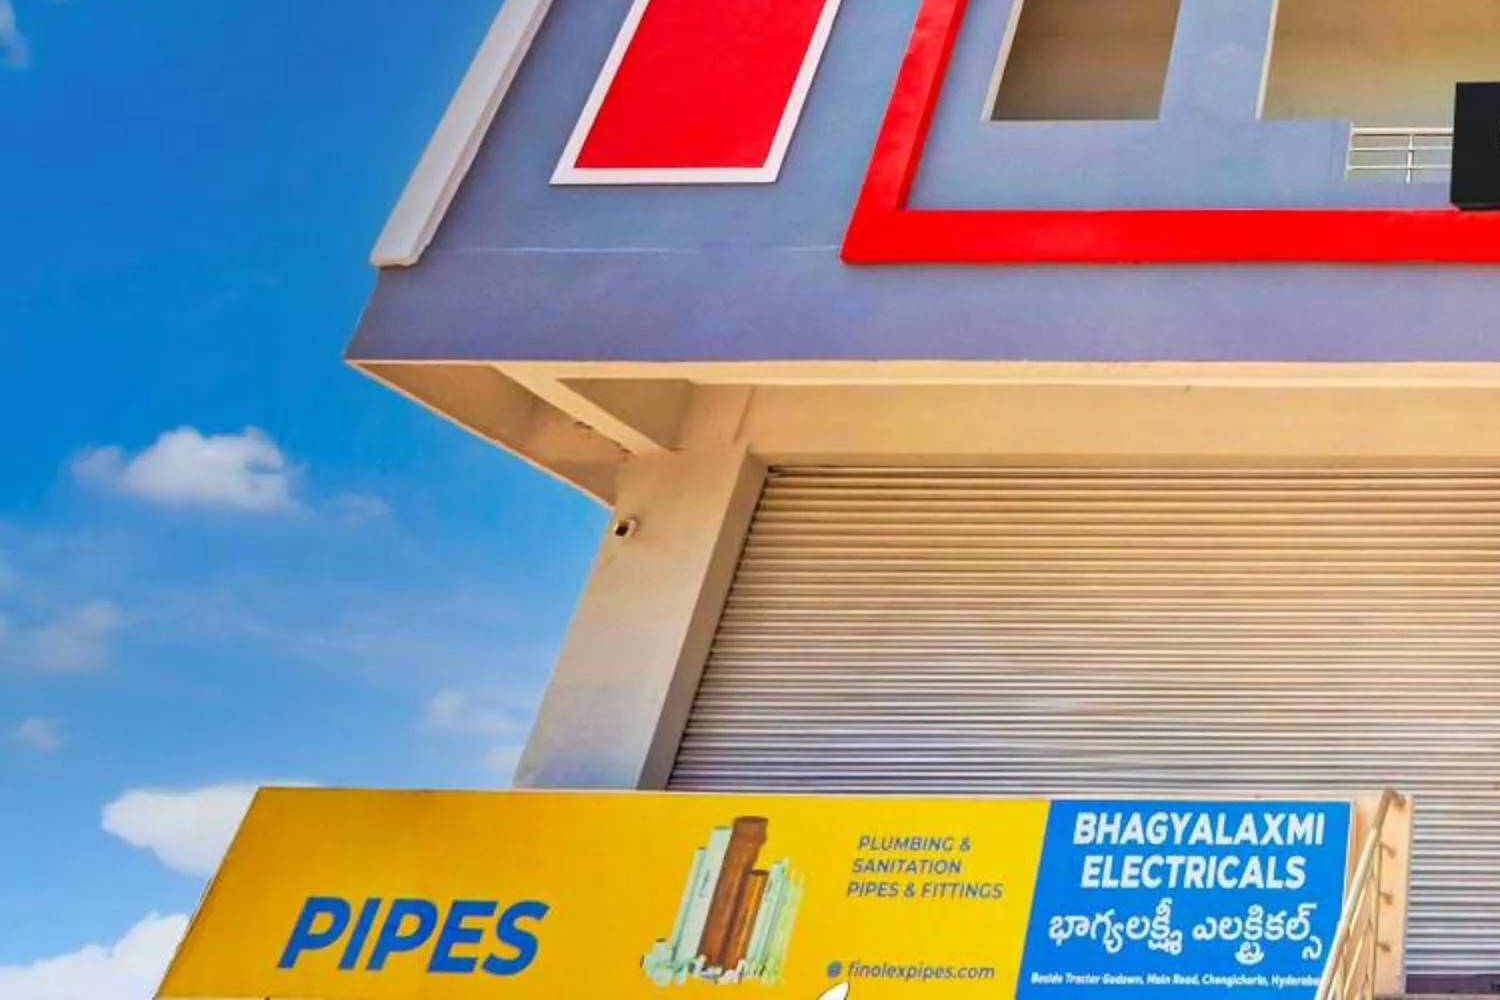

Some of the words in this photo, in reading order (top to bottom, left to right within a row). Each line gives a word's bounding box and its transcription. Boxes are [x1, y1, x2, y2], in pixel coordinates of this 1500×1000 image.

[1072, 812, 1325, 846] BHAGYALAXMI
[859, 834, 954, 852] PLUMBING
[959, 836, 971, 852] &
[852, 857, 963, 875] SANITATION
[1080, 855, 1306, 889] ELECTRICALS
[847, 881, 899, 898] PIPES
[904, 883, 915, 898] &
[920, 882, 1004, 899] FITTINGS
[278, 896, 550, 974] PIPES
[847, 960, 996, 981] finolexpipes.com
[1146, 973, 1171, 985] Main
